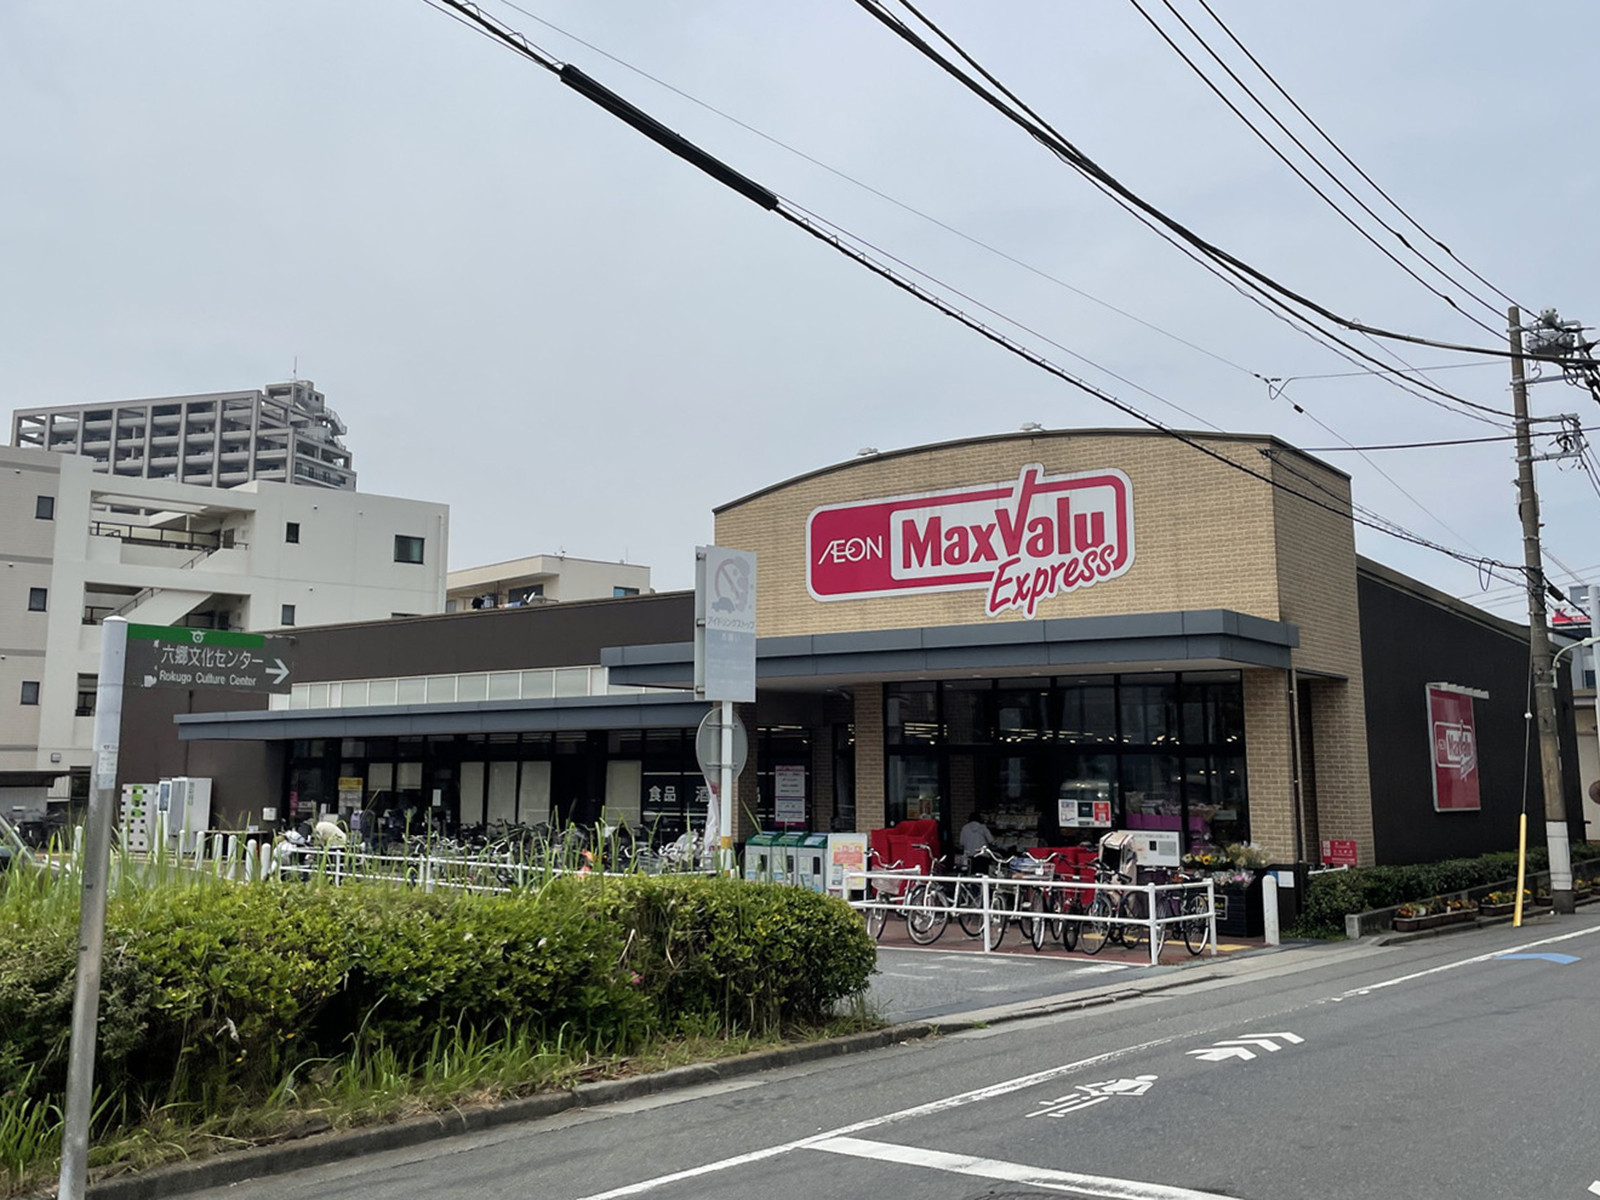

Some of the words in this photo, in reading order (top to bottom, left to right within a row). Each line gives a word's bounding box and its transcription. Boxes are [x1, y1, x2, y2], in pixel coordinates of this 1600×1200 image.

[901, 468, 1106, 570] MaxValu
[988, 544, 1115, 614] Express
[160, 644, 264, 670] 六郷文化センター
[159, 670, 193, 684] Rokugo
[195, 672, 226, 685] Culture
[229, 674, 257, 687] Center
[648, 785, 677, 803] 食品
